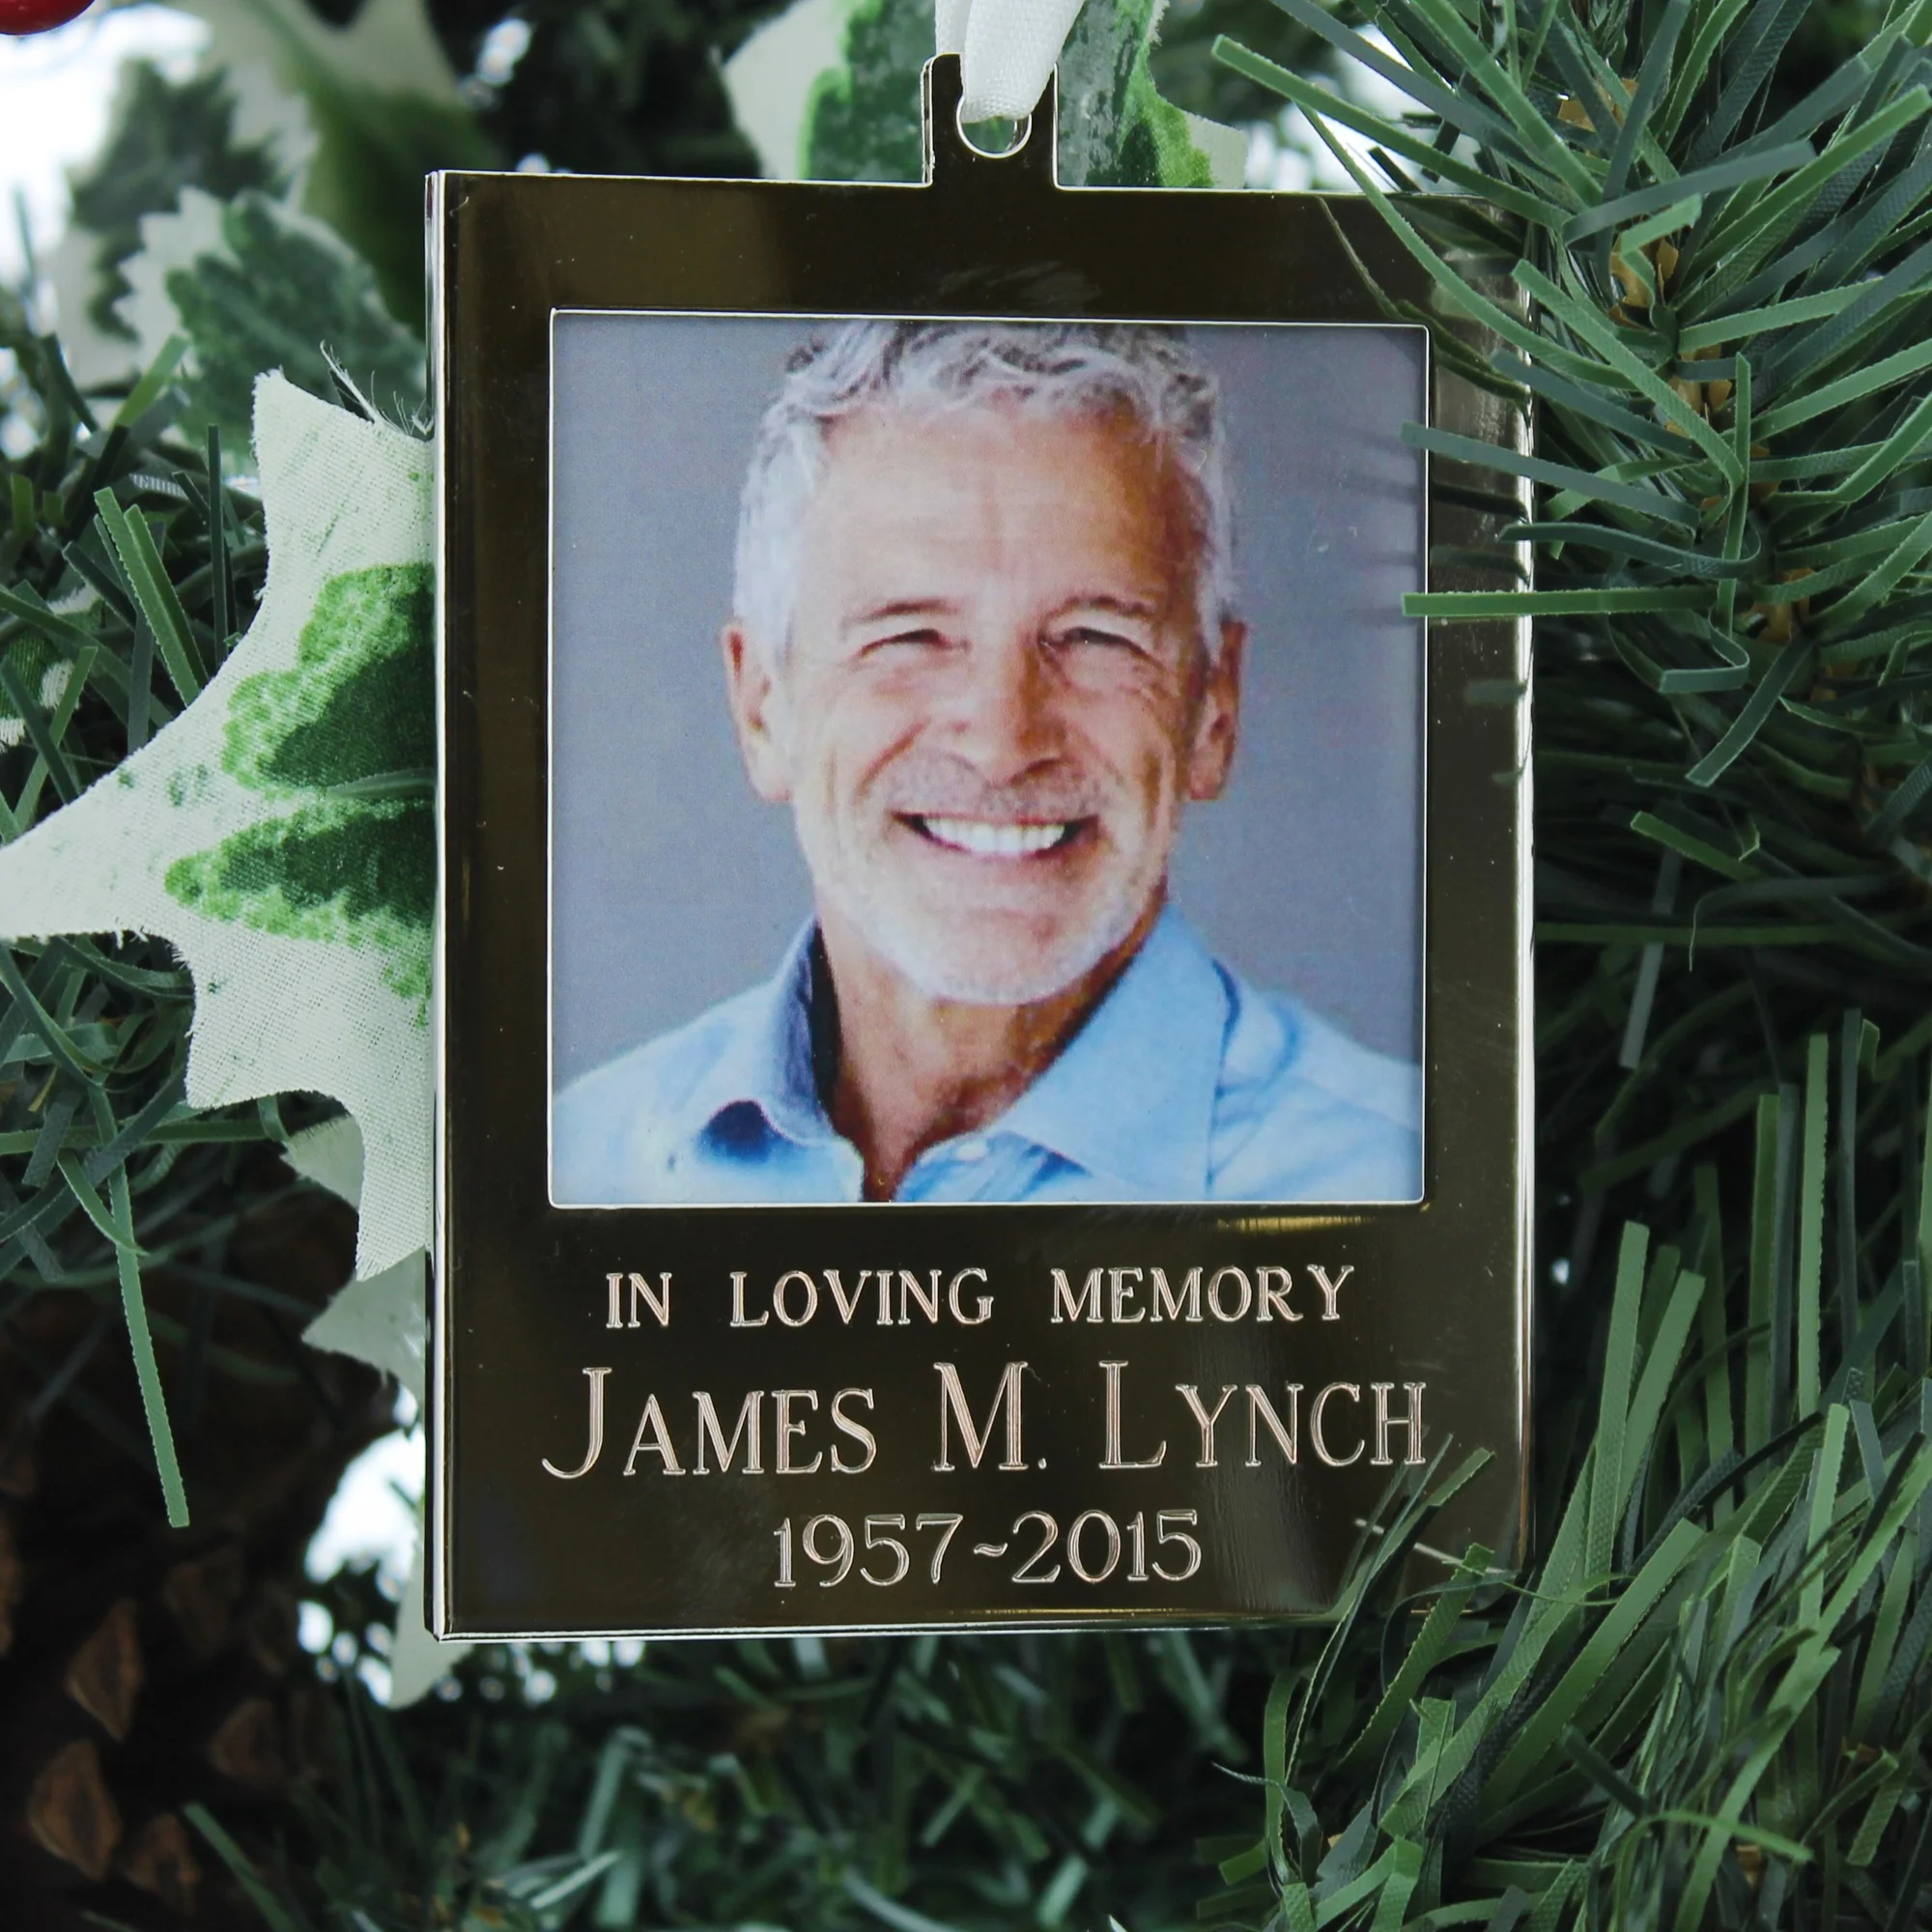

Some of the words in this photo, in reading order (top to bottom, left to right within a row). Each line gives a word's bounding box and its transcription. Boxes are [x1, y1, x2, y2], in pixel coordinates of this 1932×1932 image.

[605, 1271, 672, 1329] IN
[729, 1267, 995, 1328] LOVING
[1050, 1264, 1355, 1324] MEMORY
[541, 1366, 877, 1480] JAMES
[933, 1361, 1047, 1473] M.
[1098, 1360, 1428, 1470] LYNCH
